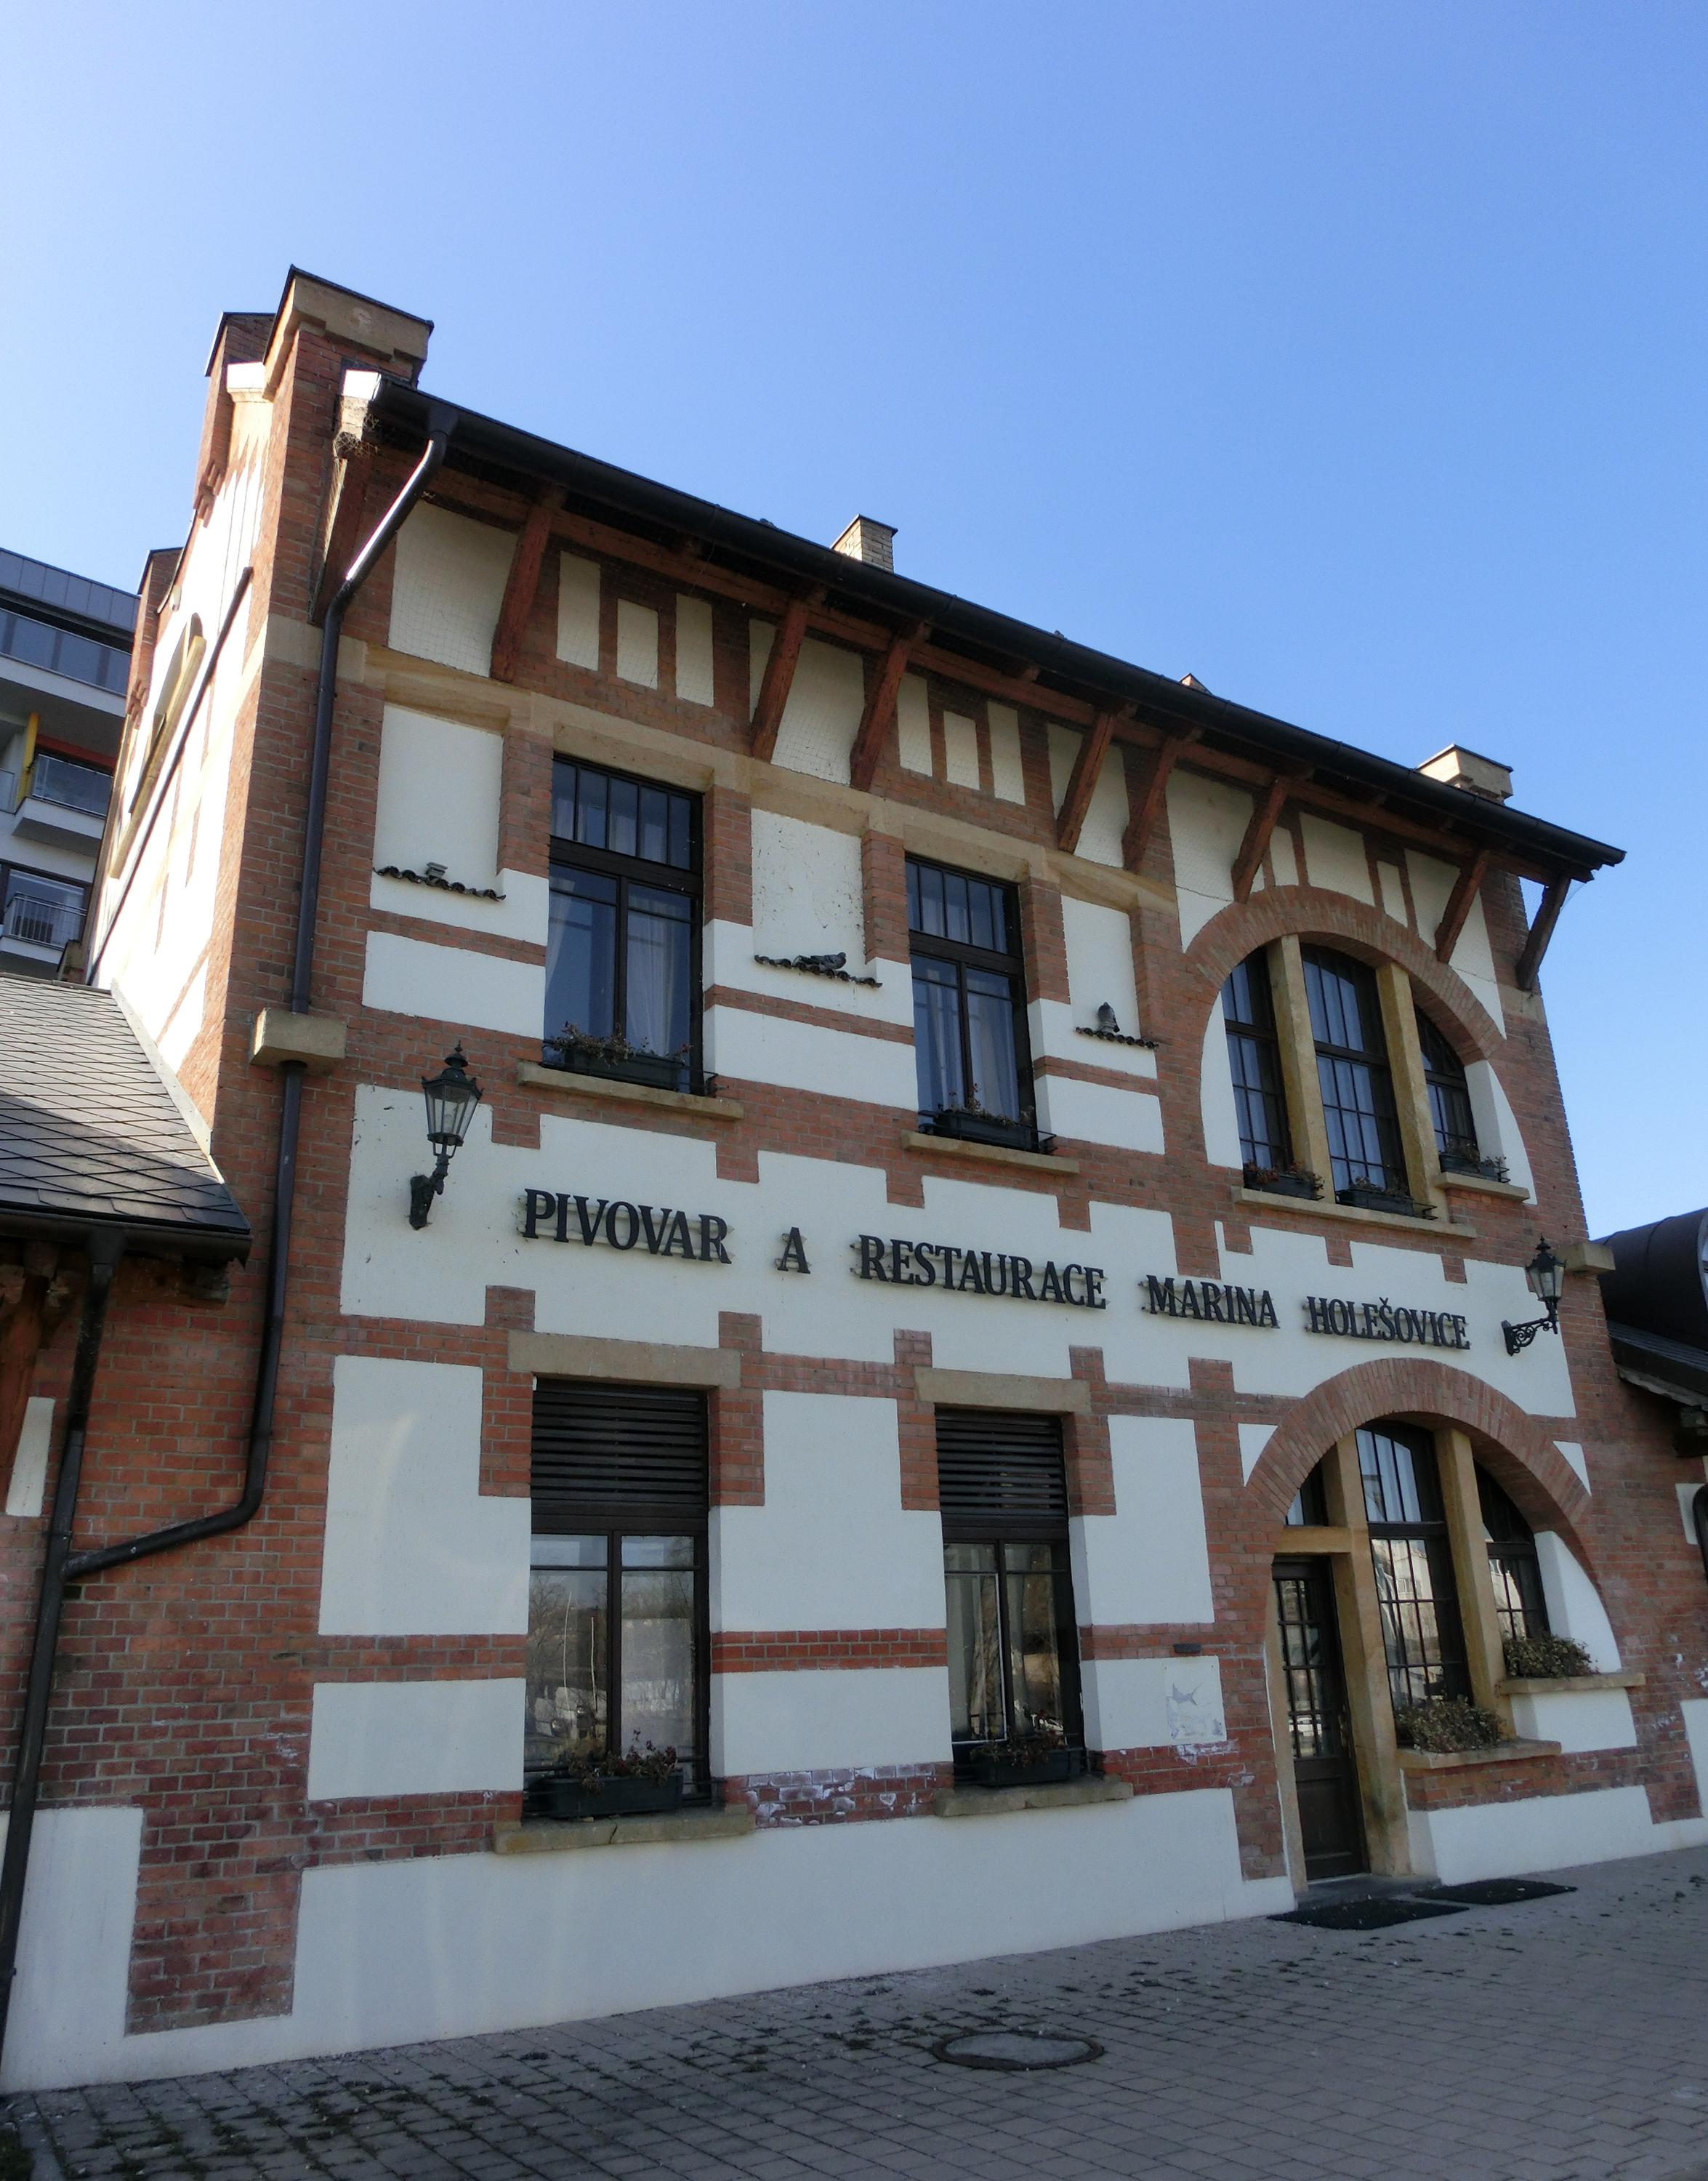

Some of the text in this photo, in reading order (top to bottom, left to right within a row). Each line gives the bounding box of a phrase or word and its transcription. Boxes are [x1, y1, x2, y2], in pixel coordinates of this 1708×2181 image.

[523, 1188, 1470, 1350] PIVOVAR A RESTAURACE MARINA HOLEŠOVICE
